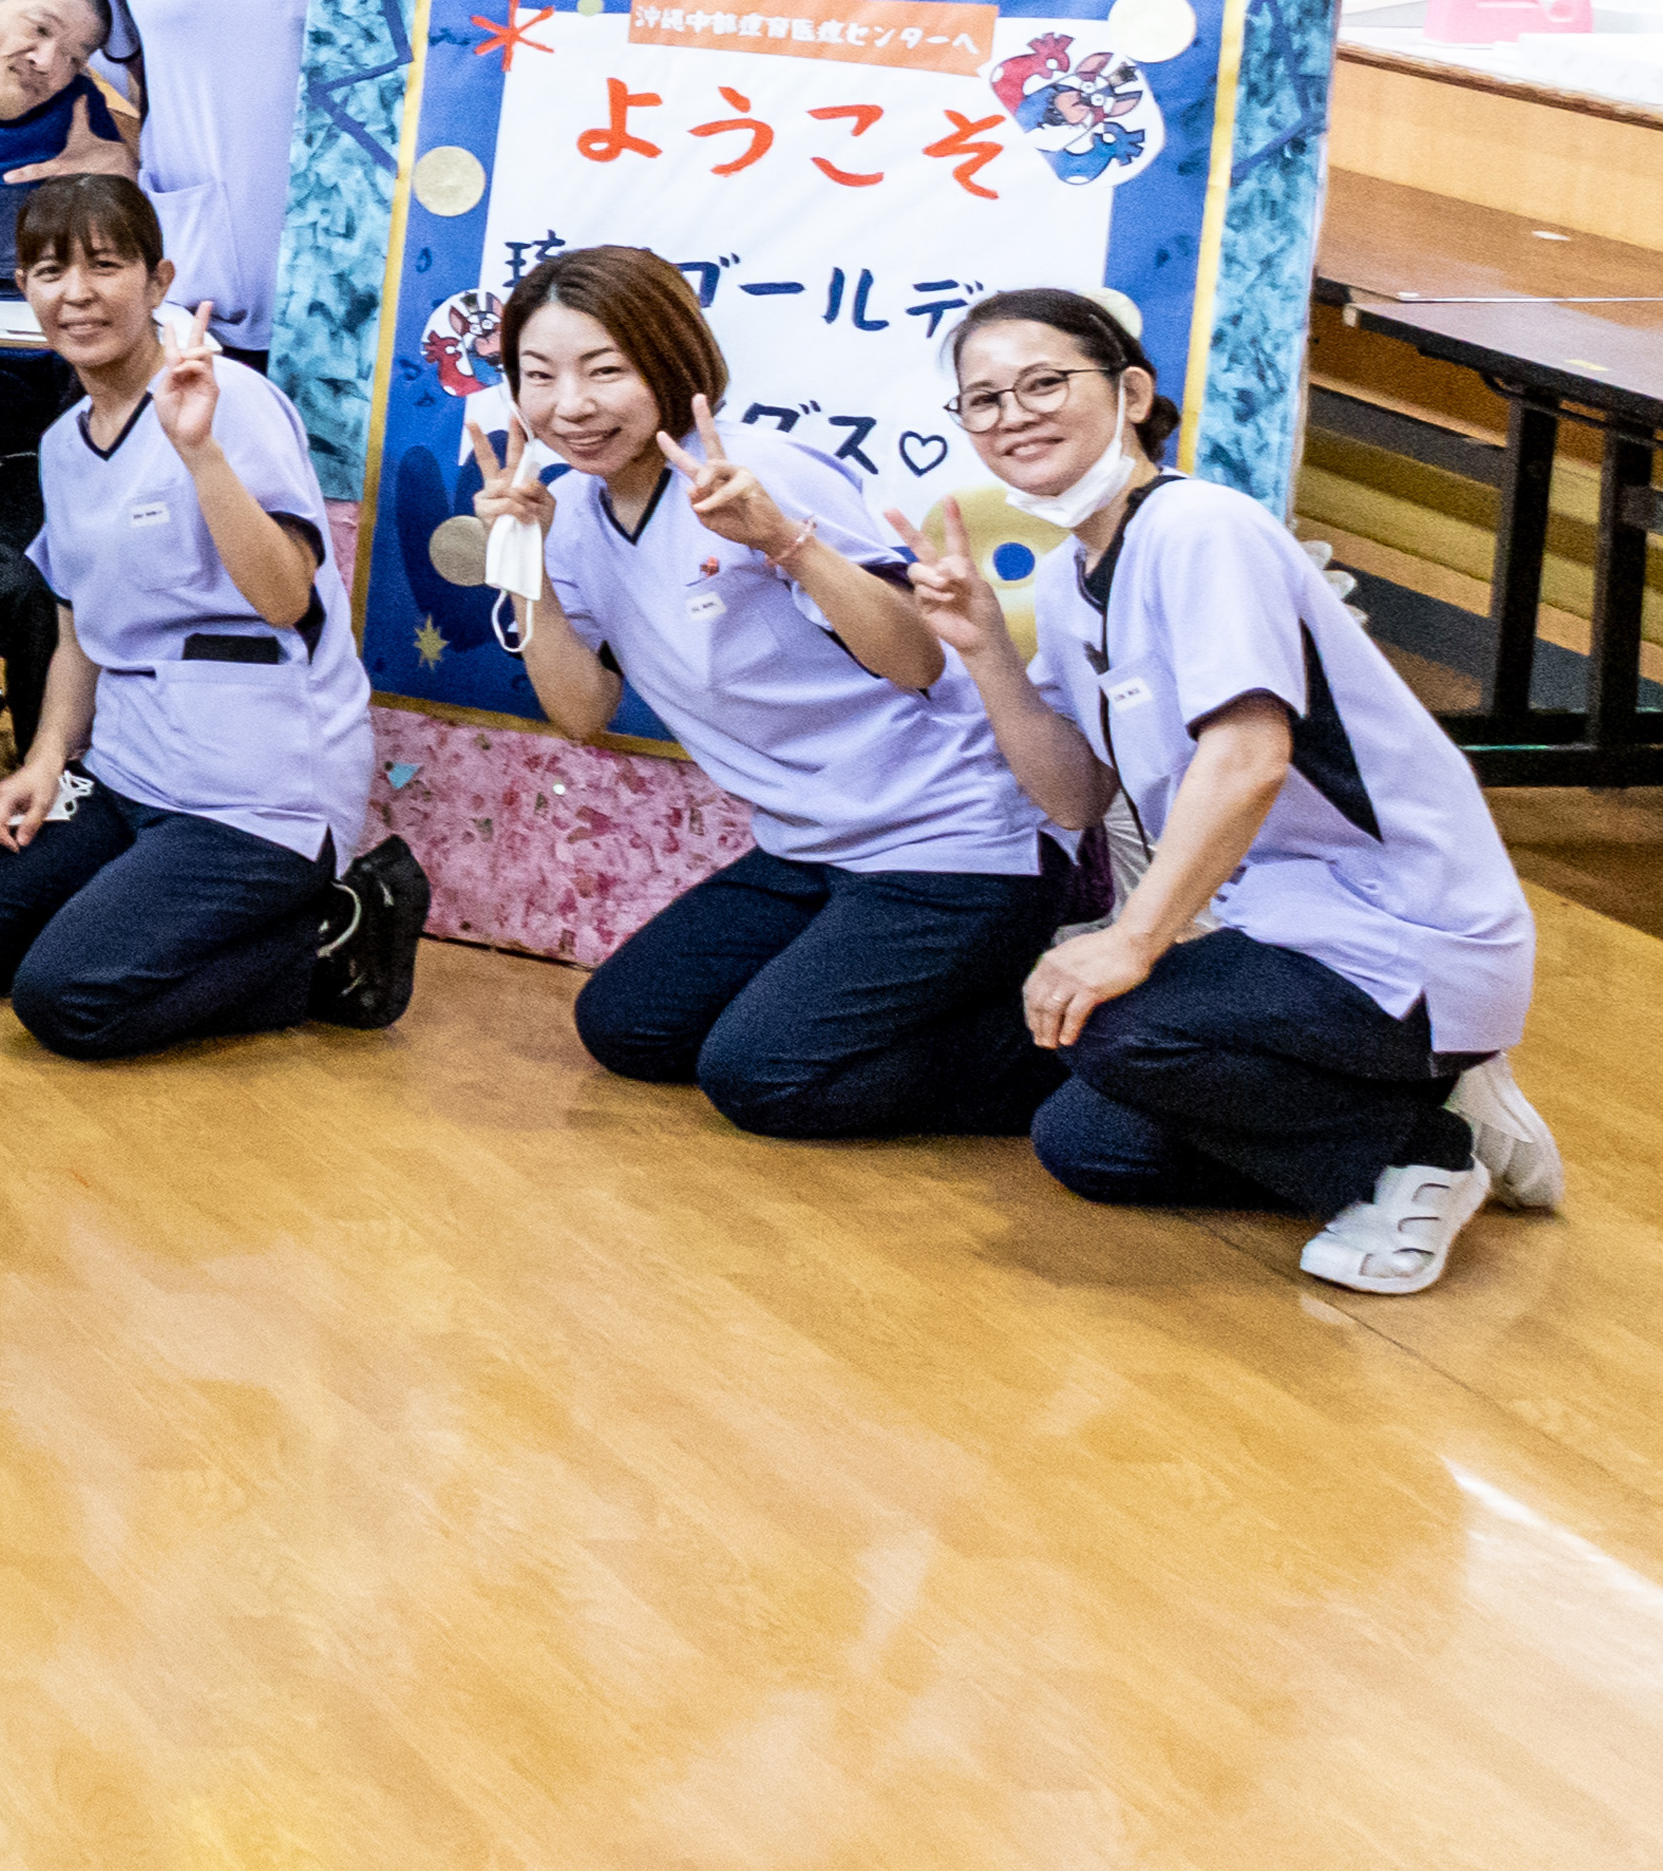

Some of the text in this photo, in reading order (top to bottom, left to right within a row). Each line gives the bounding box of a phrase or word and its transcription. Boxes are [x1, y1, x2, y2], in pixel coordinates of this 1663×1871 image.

[633, 4, 980, 55] 沖縄中部療育医療センターへ
[576, 77, 1007, 201] ようこそ
